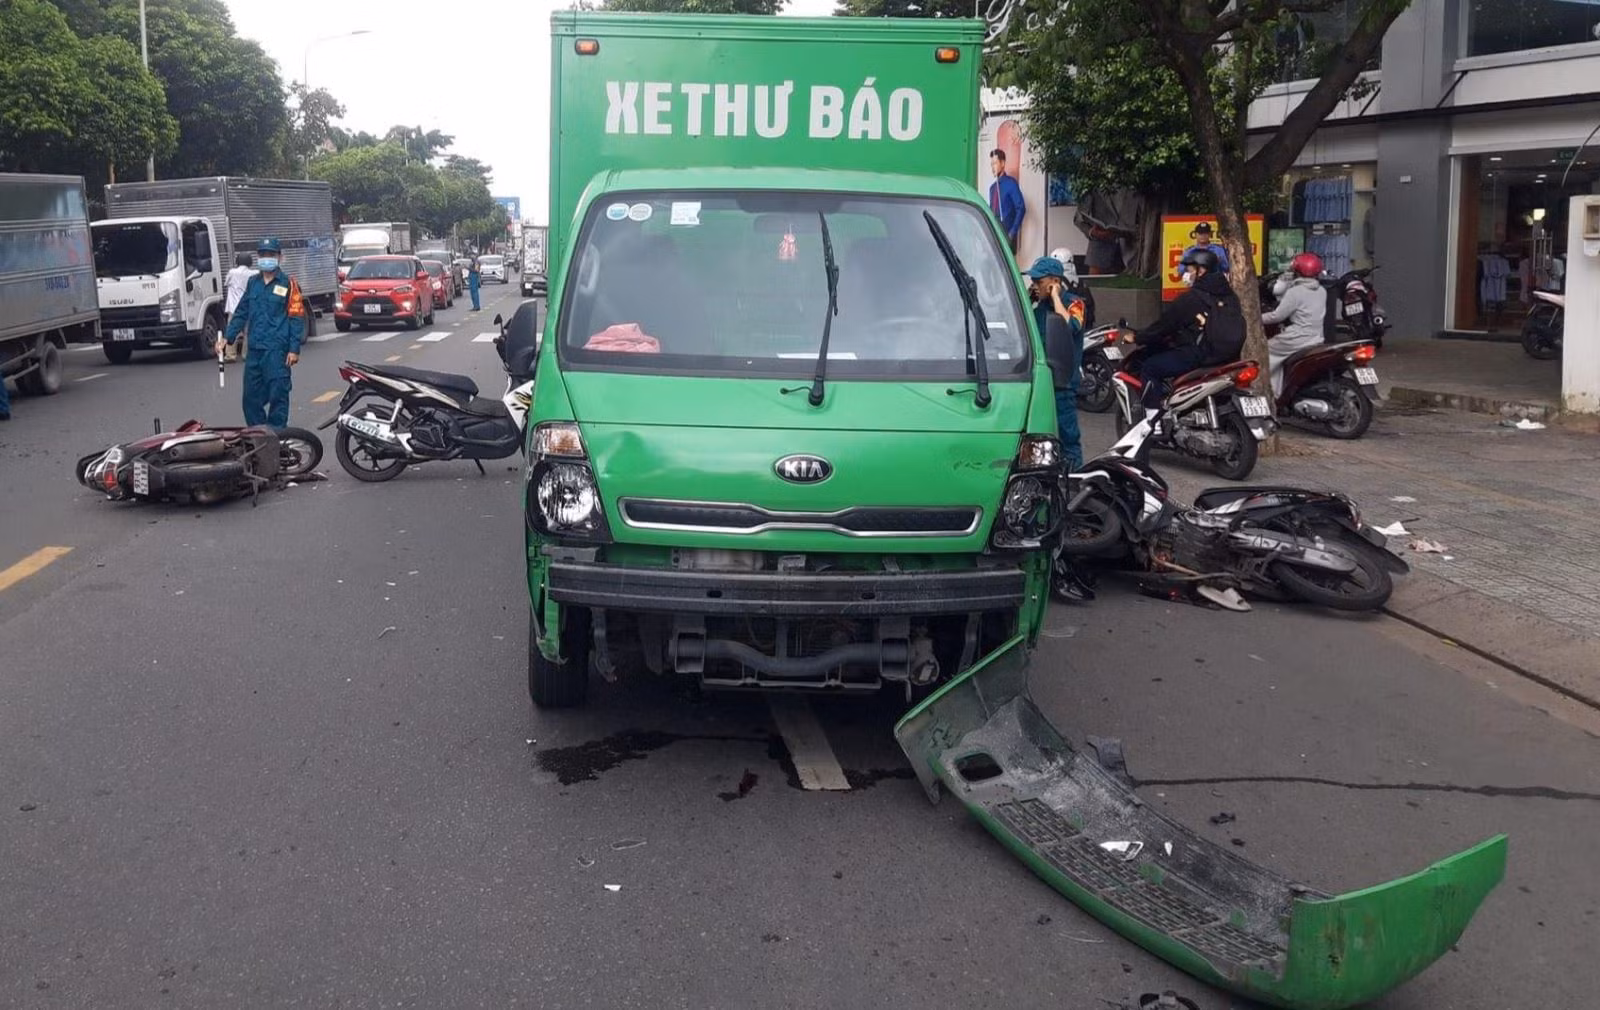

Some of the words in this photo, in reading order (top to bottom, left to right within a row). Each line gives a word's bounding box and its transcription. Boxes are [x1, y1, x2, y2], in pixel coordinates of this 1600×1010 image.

[605, 81, 673, 134] XE
[681, 80, 793, 138] THƯ
[808, 76, 923, 141] BÁO
[784, 460, 824, 478] KIA
